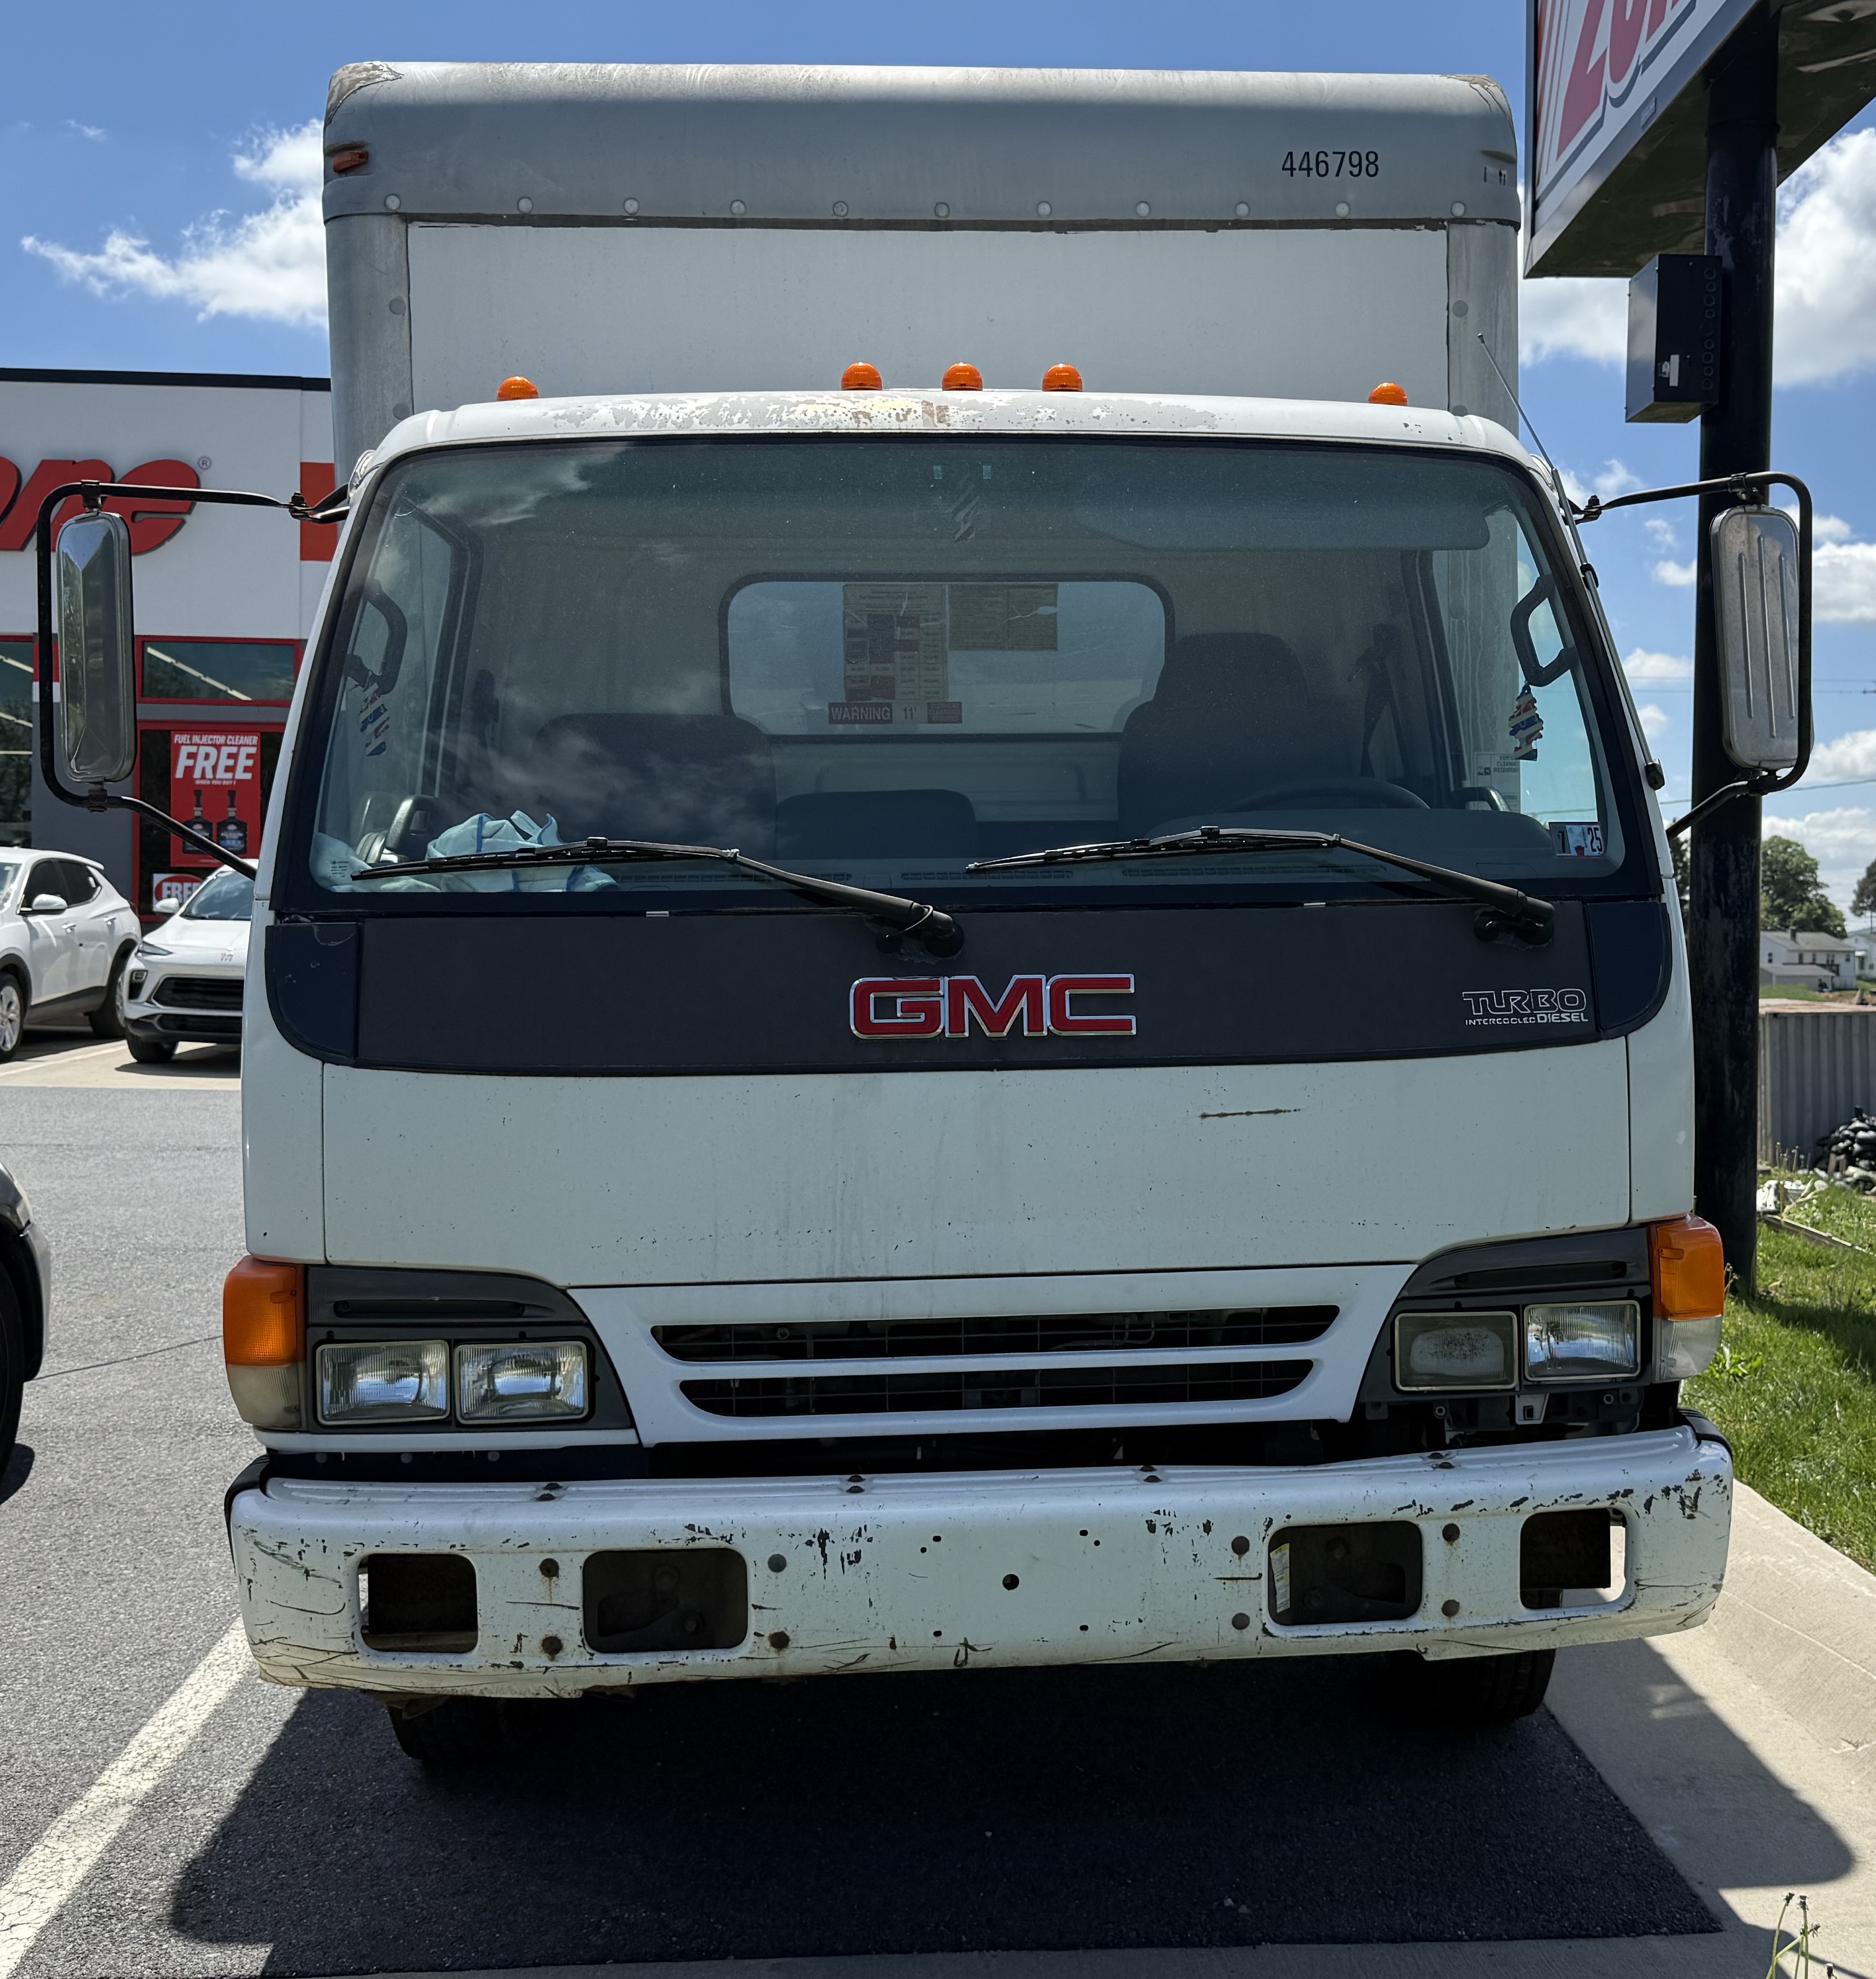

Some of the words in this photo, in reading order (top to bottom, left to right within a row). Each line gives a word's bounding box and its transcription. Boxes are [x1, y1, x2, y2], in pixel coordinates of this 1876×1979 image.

[1281, 150, 1379, 177] 446798
[831, 707, 890, 720] WARNING
[175, 734, 190, 744] FUEL
[192, 735, 226, 745] INJECTOR
[227, 735, 258, 745] CLEANER
[175, 745, 257, 779] FREE
[1587, 826, 1603, 852] 25
[850, 974, 1137, 1039] GMC
[1462, 988, 1586, 1015] TURBO
[1537, 1013, 1588, 1023] DIESEL
